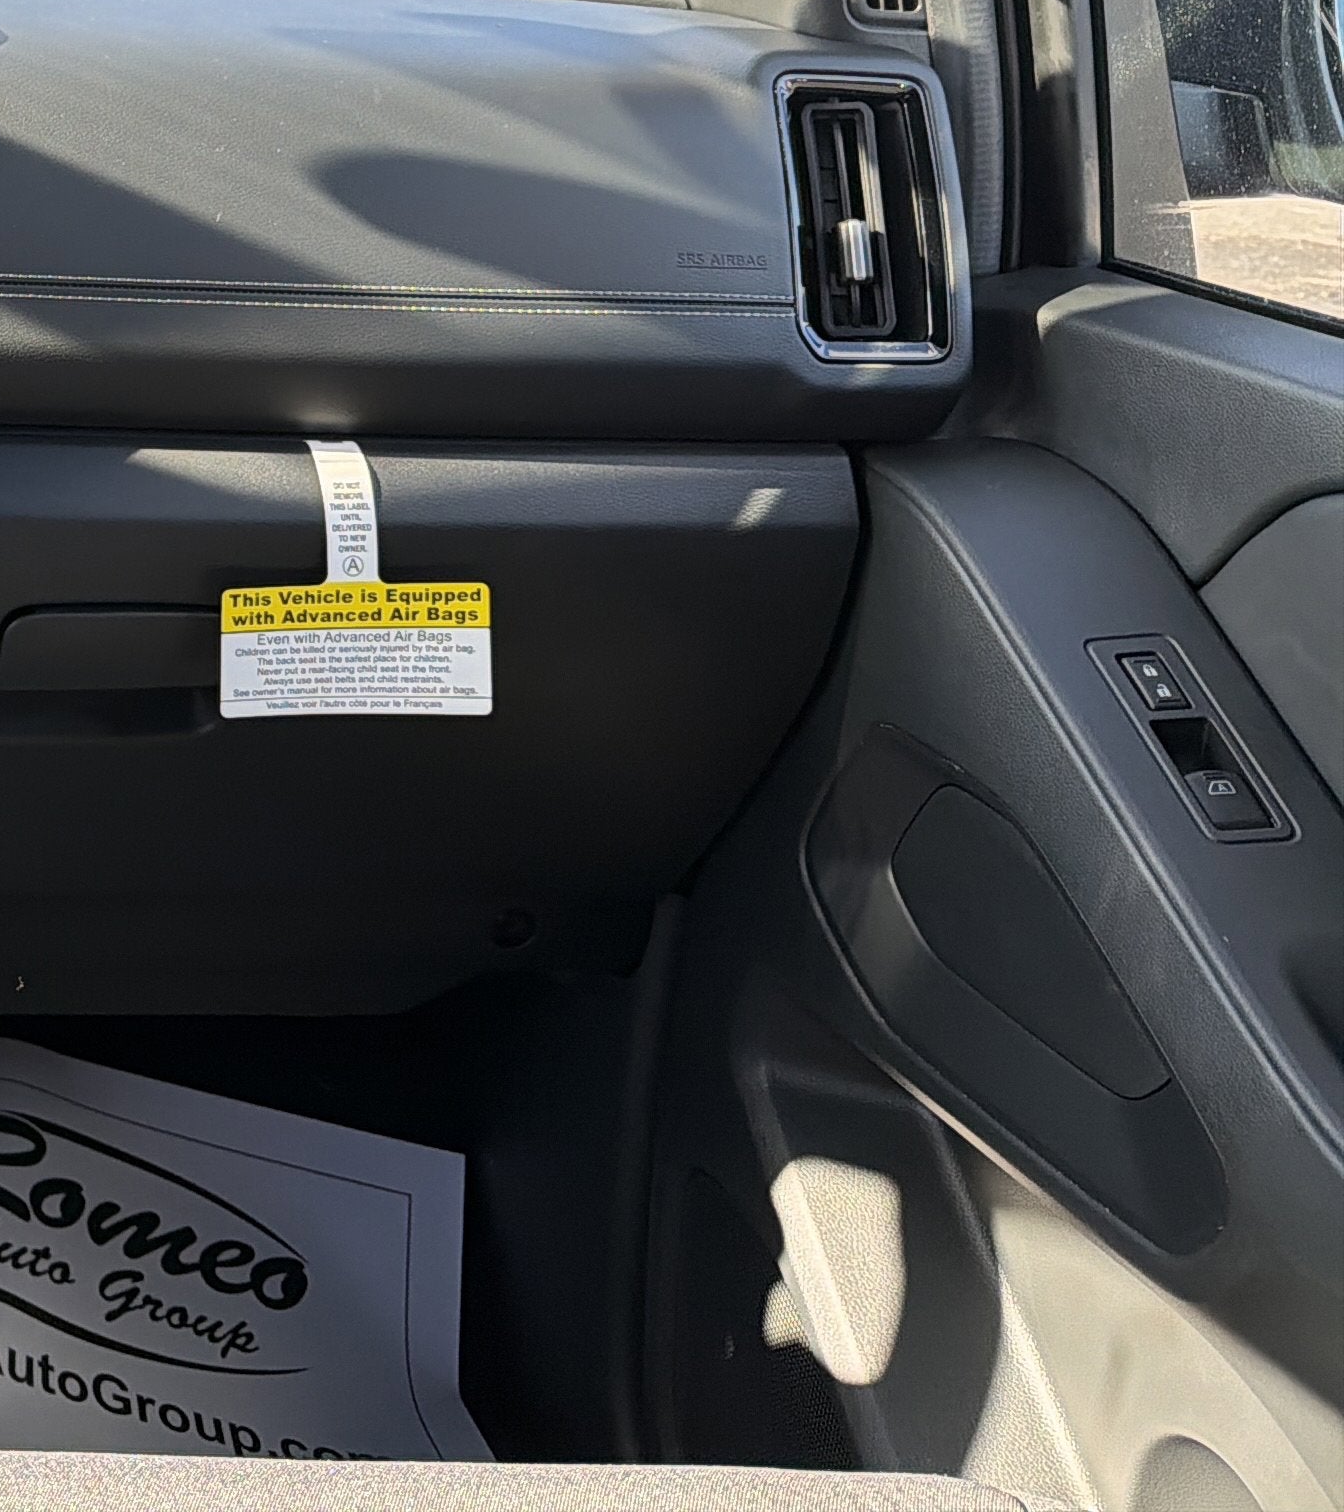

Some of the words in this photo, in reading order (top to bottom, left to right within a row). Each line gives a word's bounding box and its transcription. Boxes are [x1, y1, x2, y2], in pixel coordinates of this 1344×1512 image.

[677, 252, 705, 265] SRS
[712, 254, 768, 267] AIRBAG
[332, 523, 372, 532] DELIVERED
[229, 592, 271, 608] This
[278, 590, 354, 606] Vehicle
[360, 589, 378, 604] is
[385, 587, 482, 607] Equipped
[231, 610, 275, 626] with
[281, 608, 383, 624] Advanced
[389, 607, 421, 622] Air
[426, 606, 479, 625] Bags
[257, 633, 291, 646] Even
[294, 632, 322, 645] with
[324, 631, 392, 645] Advanced
[394, 630, 413, 642] Air
[417, 630, 453, 645] Bags
[235, 647, 271, 657] Children
[272, 648, 288, 656] can
[289, 646, 301, 655] be
[303, 645, 326, 654] killed
[338, 645, 377, 655] seriously
[380, 644, 410, 655] injured
[412, 645, 424, 655] by
[426, 644, 440, 653] the
[442, 644, 454, 652] air
[99, 1270, 260, 1358] Group
